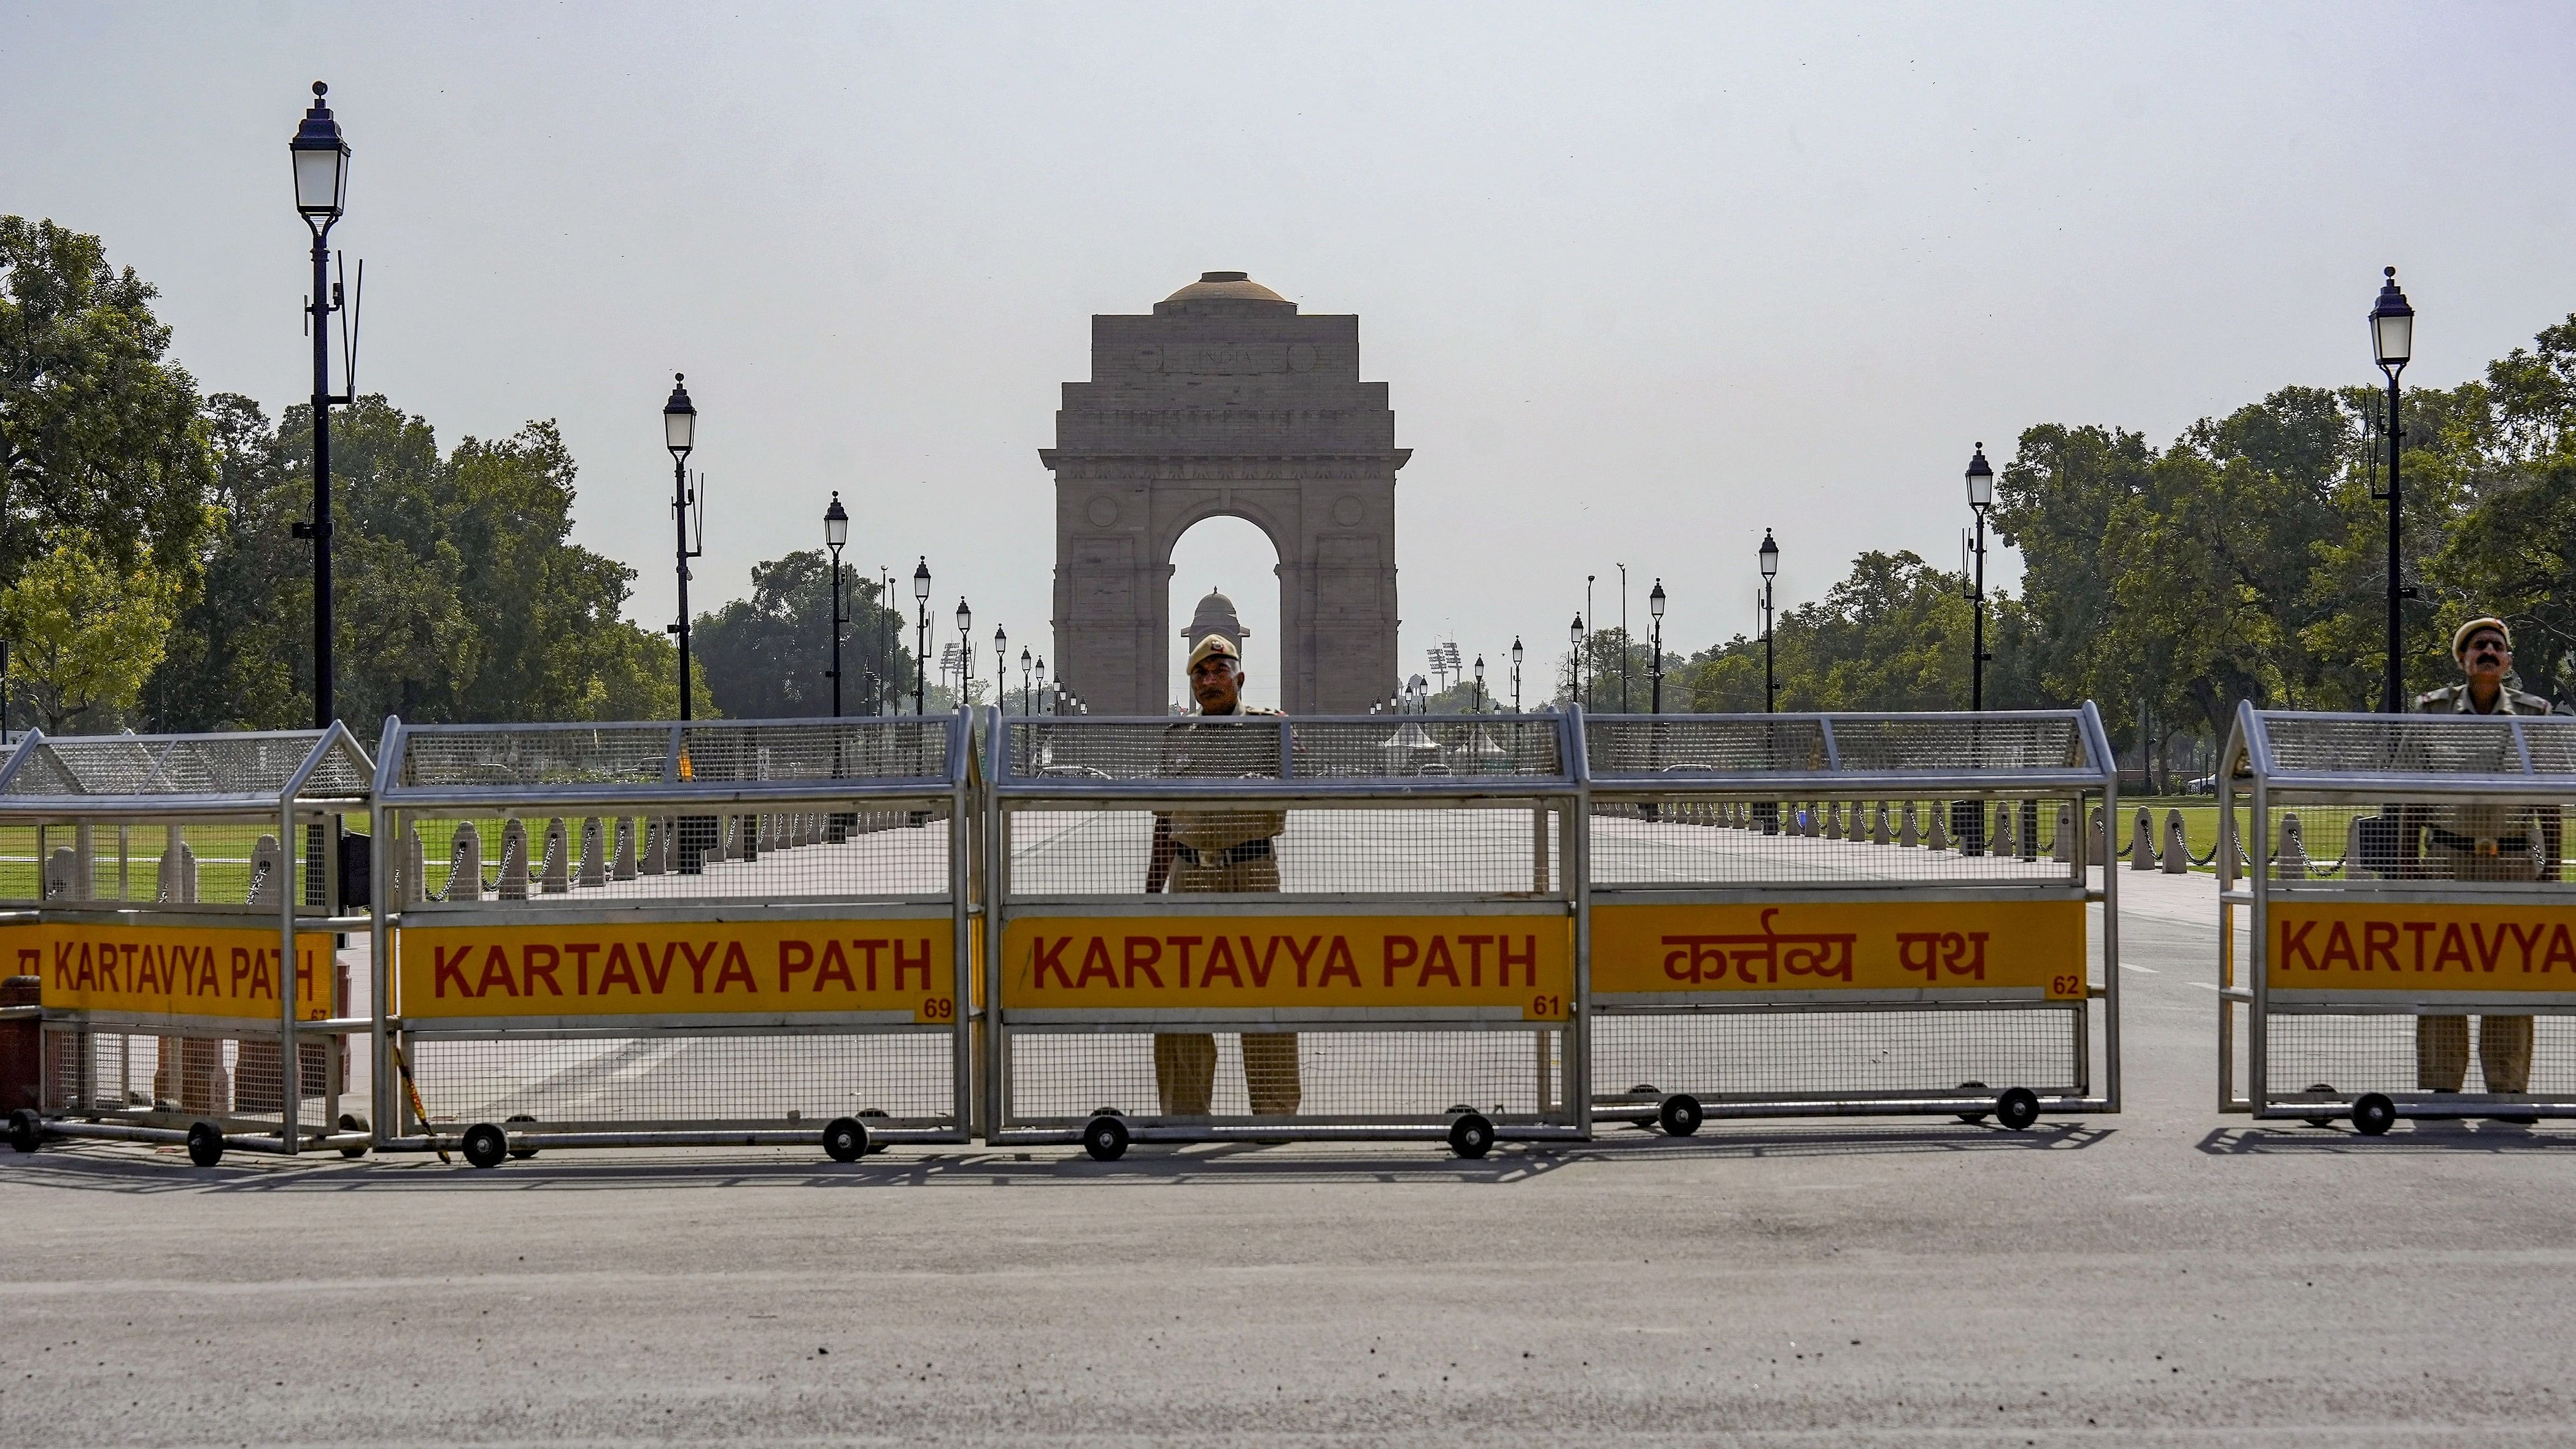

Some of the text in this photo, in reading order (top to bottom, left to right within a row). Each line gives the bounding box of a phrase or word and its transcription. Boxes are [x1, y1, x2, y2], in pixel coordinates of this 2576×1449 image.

[1199, 351, 1251, 363] INDIA
[55, 942, 220, 997] KARTAVYA
[231, 948, 314, 1002] PATH
[435, 939, 931, 998] KARTAVYA PATH
[1034, 933, 1537, 989] KARTAVYA PATH
[1661, 908, 1989, 984] कर्त्तव्य पथ
[2281, 921, 2576, 973] KARTAVYA
[924, 997, 951, 1018] 69
[1533, 995, 1559, 1016] 61
[2053, 975, 2079, 995] 62
